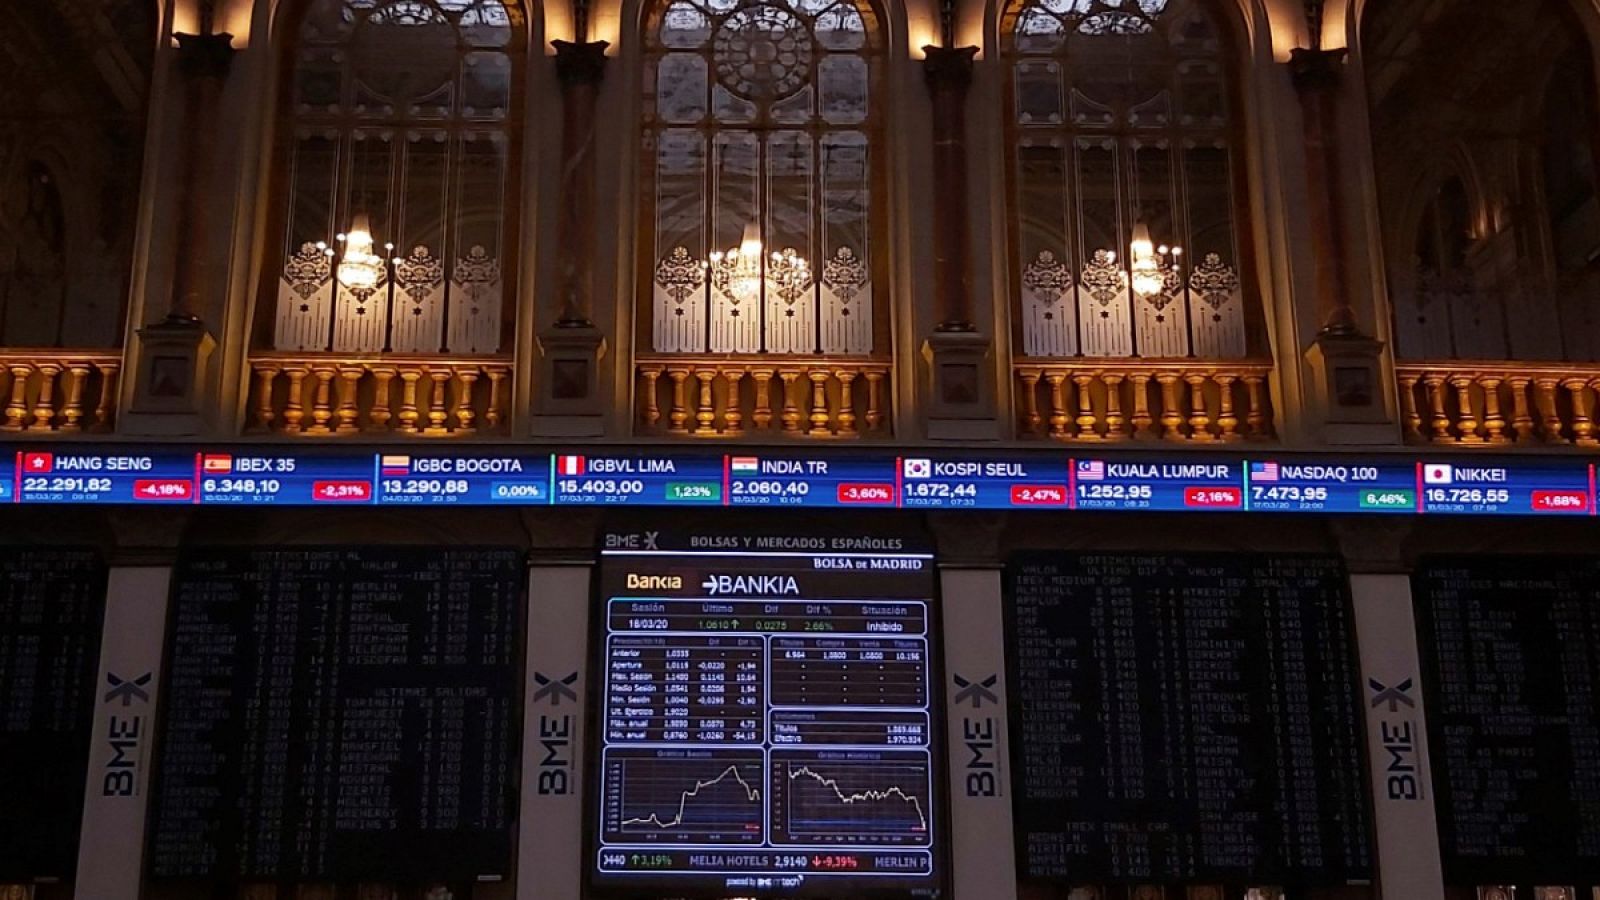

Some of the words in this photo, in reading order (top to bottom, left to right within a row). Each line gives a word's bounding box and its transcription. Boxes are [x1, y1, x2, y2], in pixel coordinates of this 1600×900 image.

[56, 457, 102, 470] HANG
[106, 457, 152, 470] SENG
[236, 458, 272, 472] IBEX
[276, 458, 296, 472] 35
[414, 459, 452, 472] IGBC
[456, 459, 522, 472] BOGOTA
[589, 460, 634, 472] IGBVL
[639, 460, 676, 472] LIMA
[762, 460, 804, 474] INDIA
[807, 460, 828, 474] TR
[934, 462, 981, 476] KOSPI
[986, 463, 1028, 476] SEUL
[1108, 464, 1160, 478] KUALA
[1163, 464, 1228, 478] LUMPUR
[1282, 466, 1348, 482] NASDAQ
[1351, 467, 1377, 480] 100
[1455, 468, 1506, 482] NIKKEI
[24, 478, 112, 492] 22.291,82
[204, 480, 280, 494] 6.348,10
[320, 486, 364, 496] -2,31%
[382, 480, 468, 494] 13.290,88
[498, 486, 538, 497] 0,00%
[559, 480, 644, 495] 15.403,00
[674, 487, 711, 498] 1,23%
[732, 481, 808, 496] 2.060,40
[844, 488, 888, 499] -3,60%
[905, 484, 976, 498] 1.672,44
[1016, 490, 1060, 502] -2,47%
[1078, 485, 1152, 500] 1.252,95
[1191, 492, 1234, 504] -2,16%
[1252, 487, 1328, 502] 7.473,95
[1366, 494, 1408, 505] 6,46%
[1426, 488, 1508, 504] 16.726,55
[1539, 496, 1581, 506] -1,68%
[606, 534, 640, 548] BME
[691, 536, 738, 548] BOLSAS
[744, 537, 752, 548] Y
[757, 537, 826, 549] MERCADOS
[832, 536, 902, 549] ESPAÑOLES
[814, 558, 853, 569] BOLSA
[870, 559, 922, 570] MADRID
[627, 573, 682, 589] Bankia
[718, 575, 800, 594] BANKIA
[866, 622, 903, 632] Inhibido
[104, 716, 140, 796] BME
[538, 715, 568, 794] BME
[964, 718, 996, 796] BME
[1382, 721, 1417, 800] BME
[690, 855, 724, 866] MELIA
[726, 856, 769, 866] HOTELS
[875, 856, 917, 868] MERLIN
